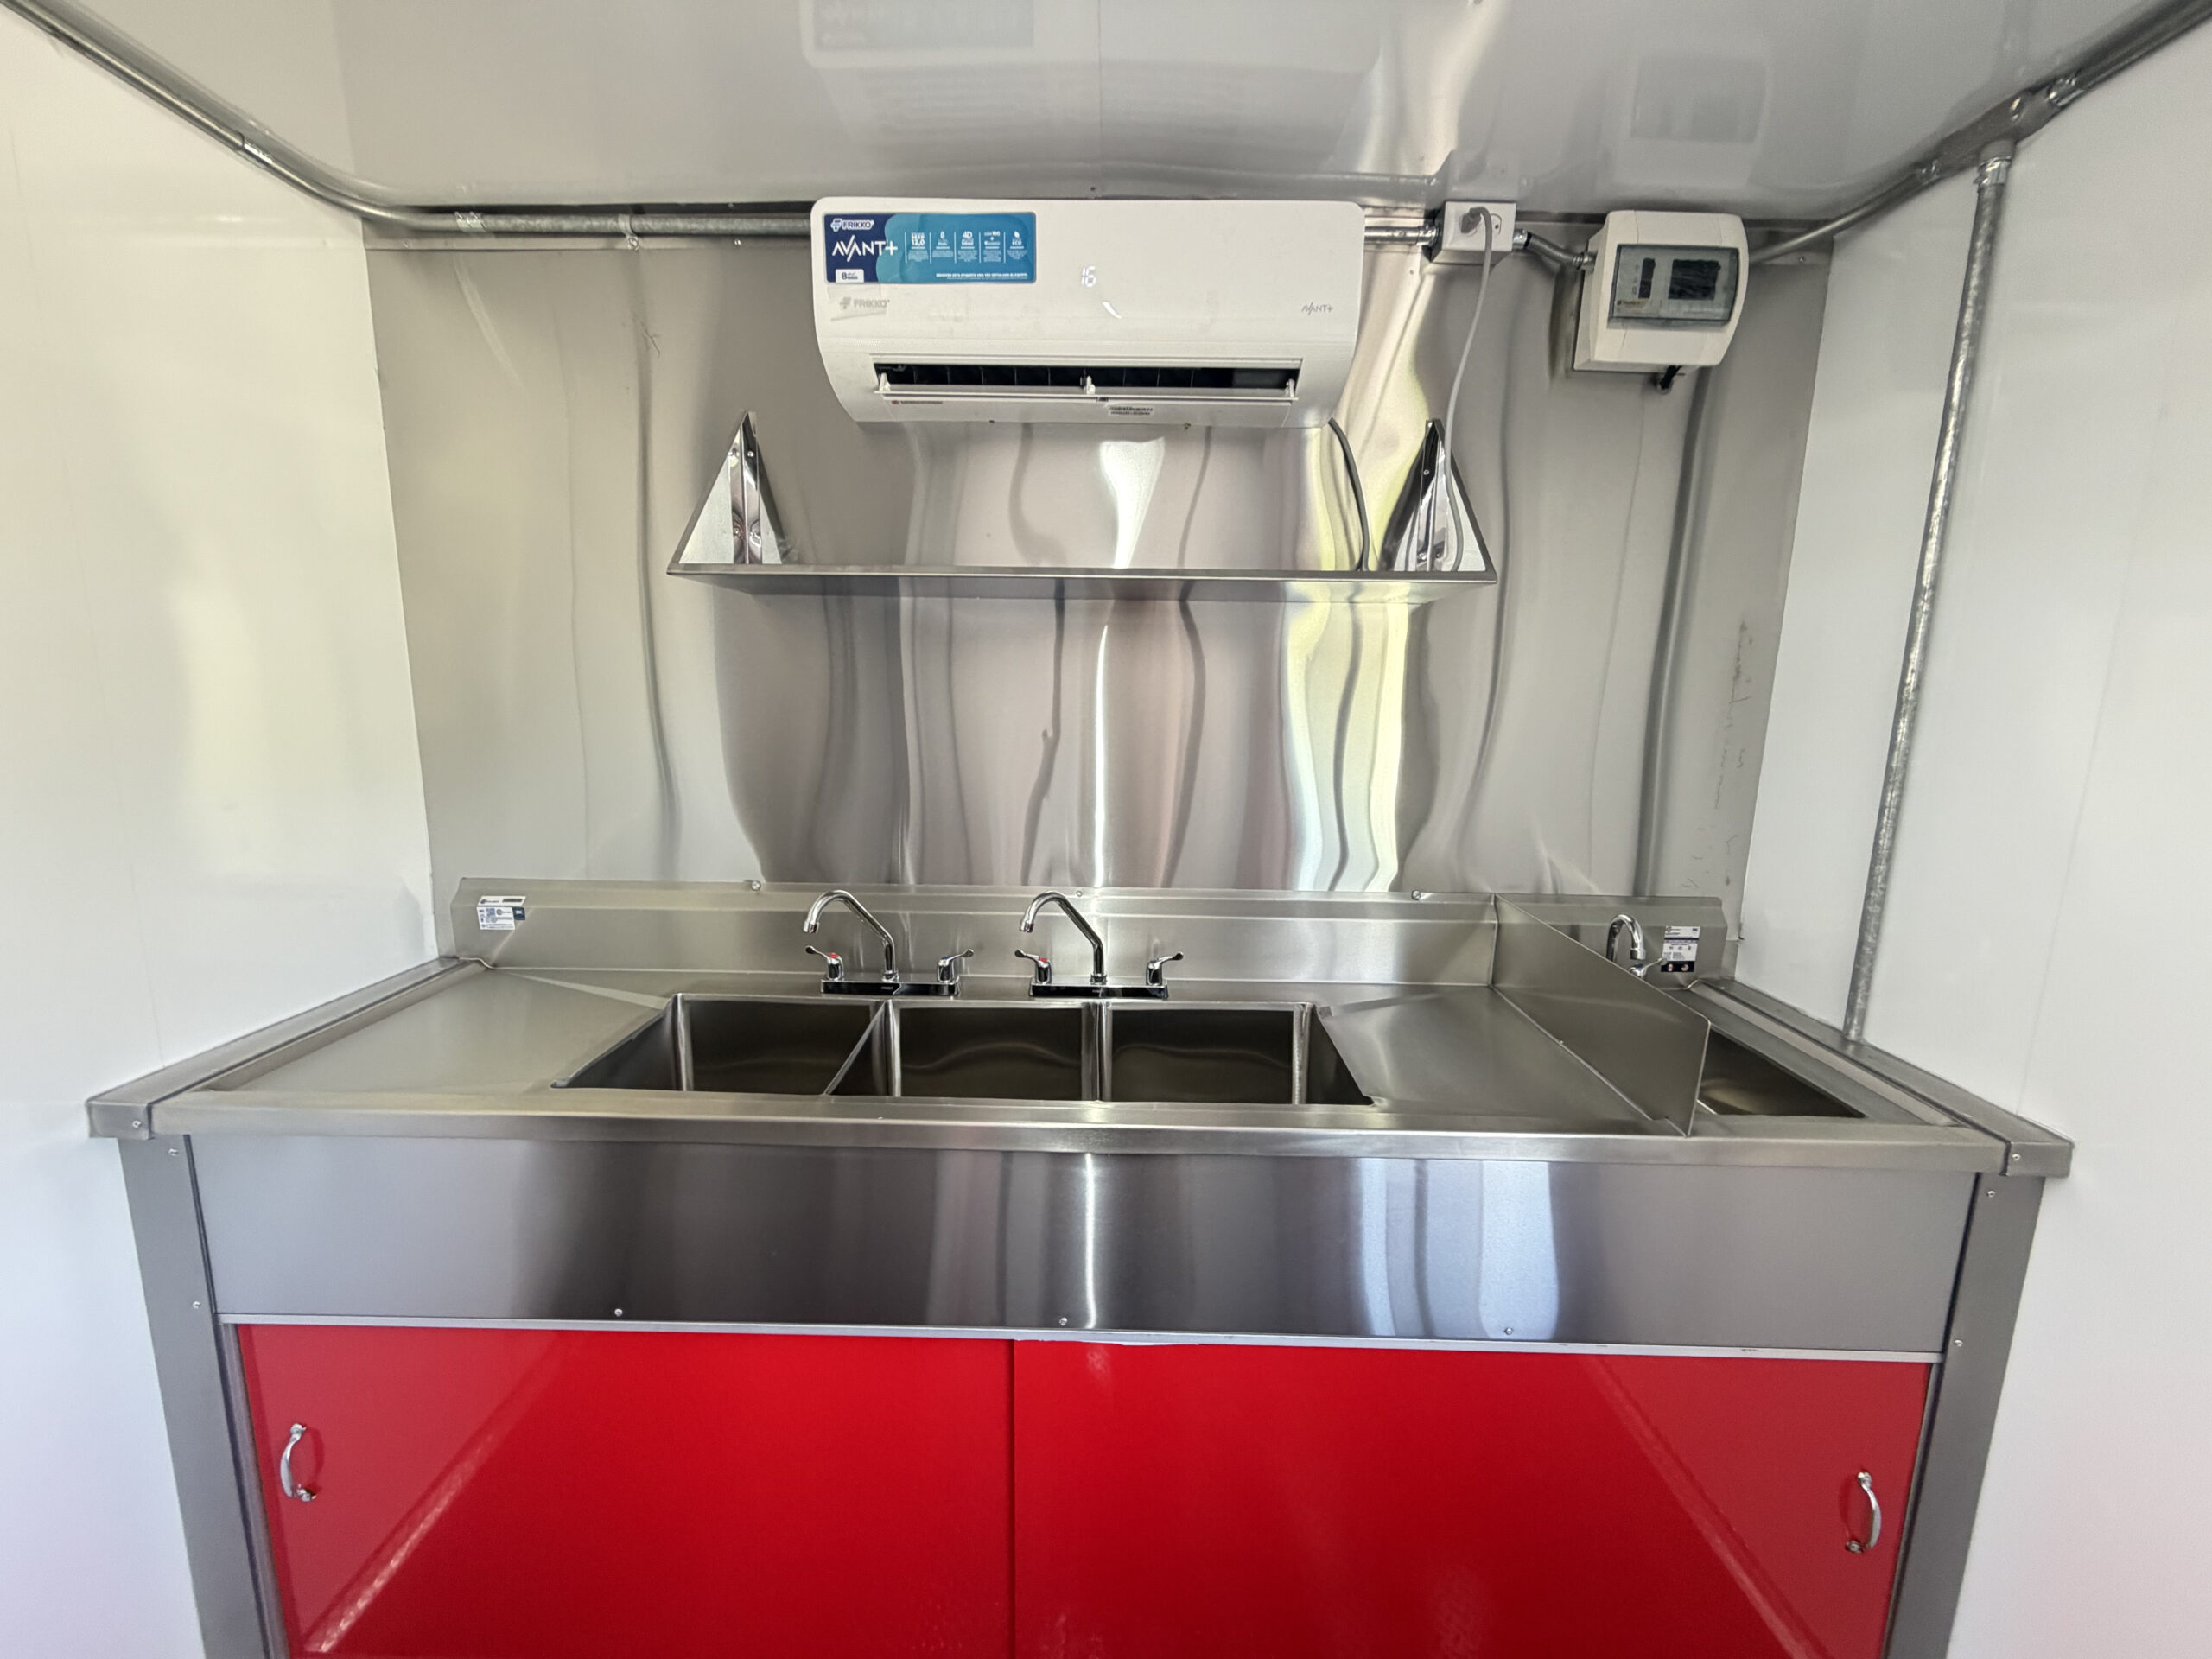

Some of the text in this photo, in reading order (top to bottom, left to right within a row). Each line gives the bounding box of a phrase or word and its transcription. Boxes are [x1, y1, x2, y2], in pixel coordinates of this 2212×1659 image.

[842, 220, 872, 229] FRIKKO
[831, 234, 898, 262] AVANT+
[1081, 266, 1096, 287] 16
[853, 299, 887, 308] FRIKKO
